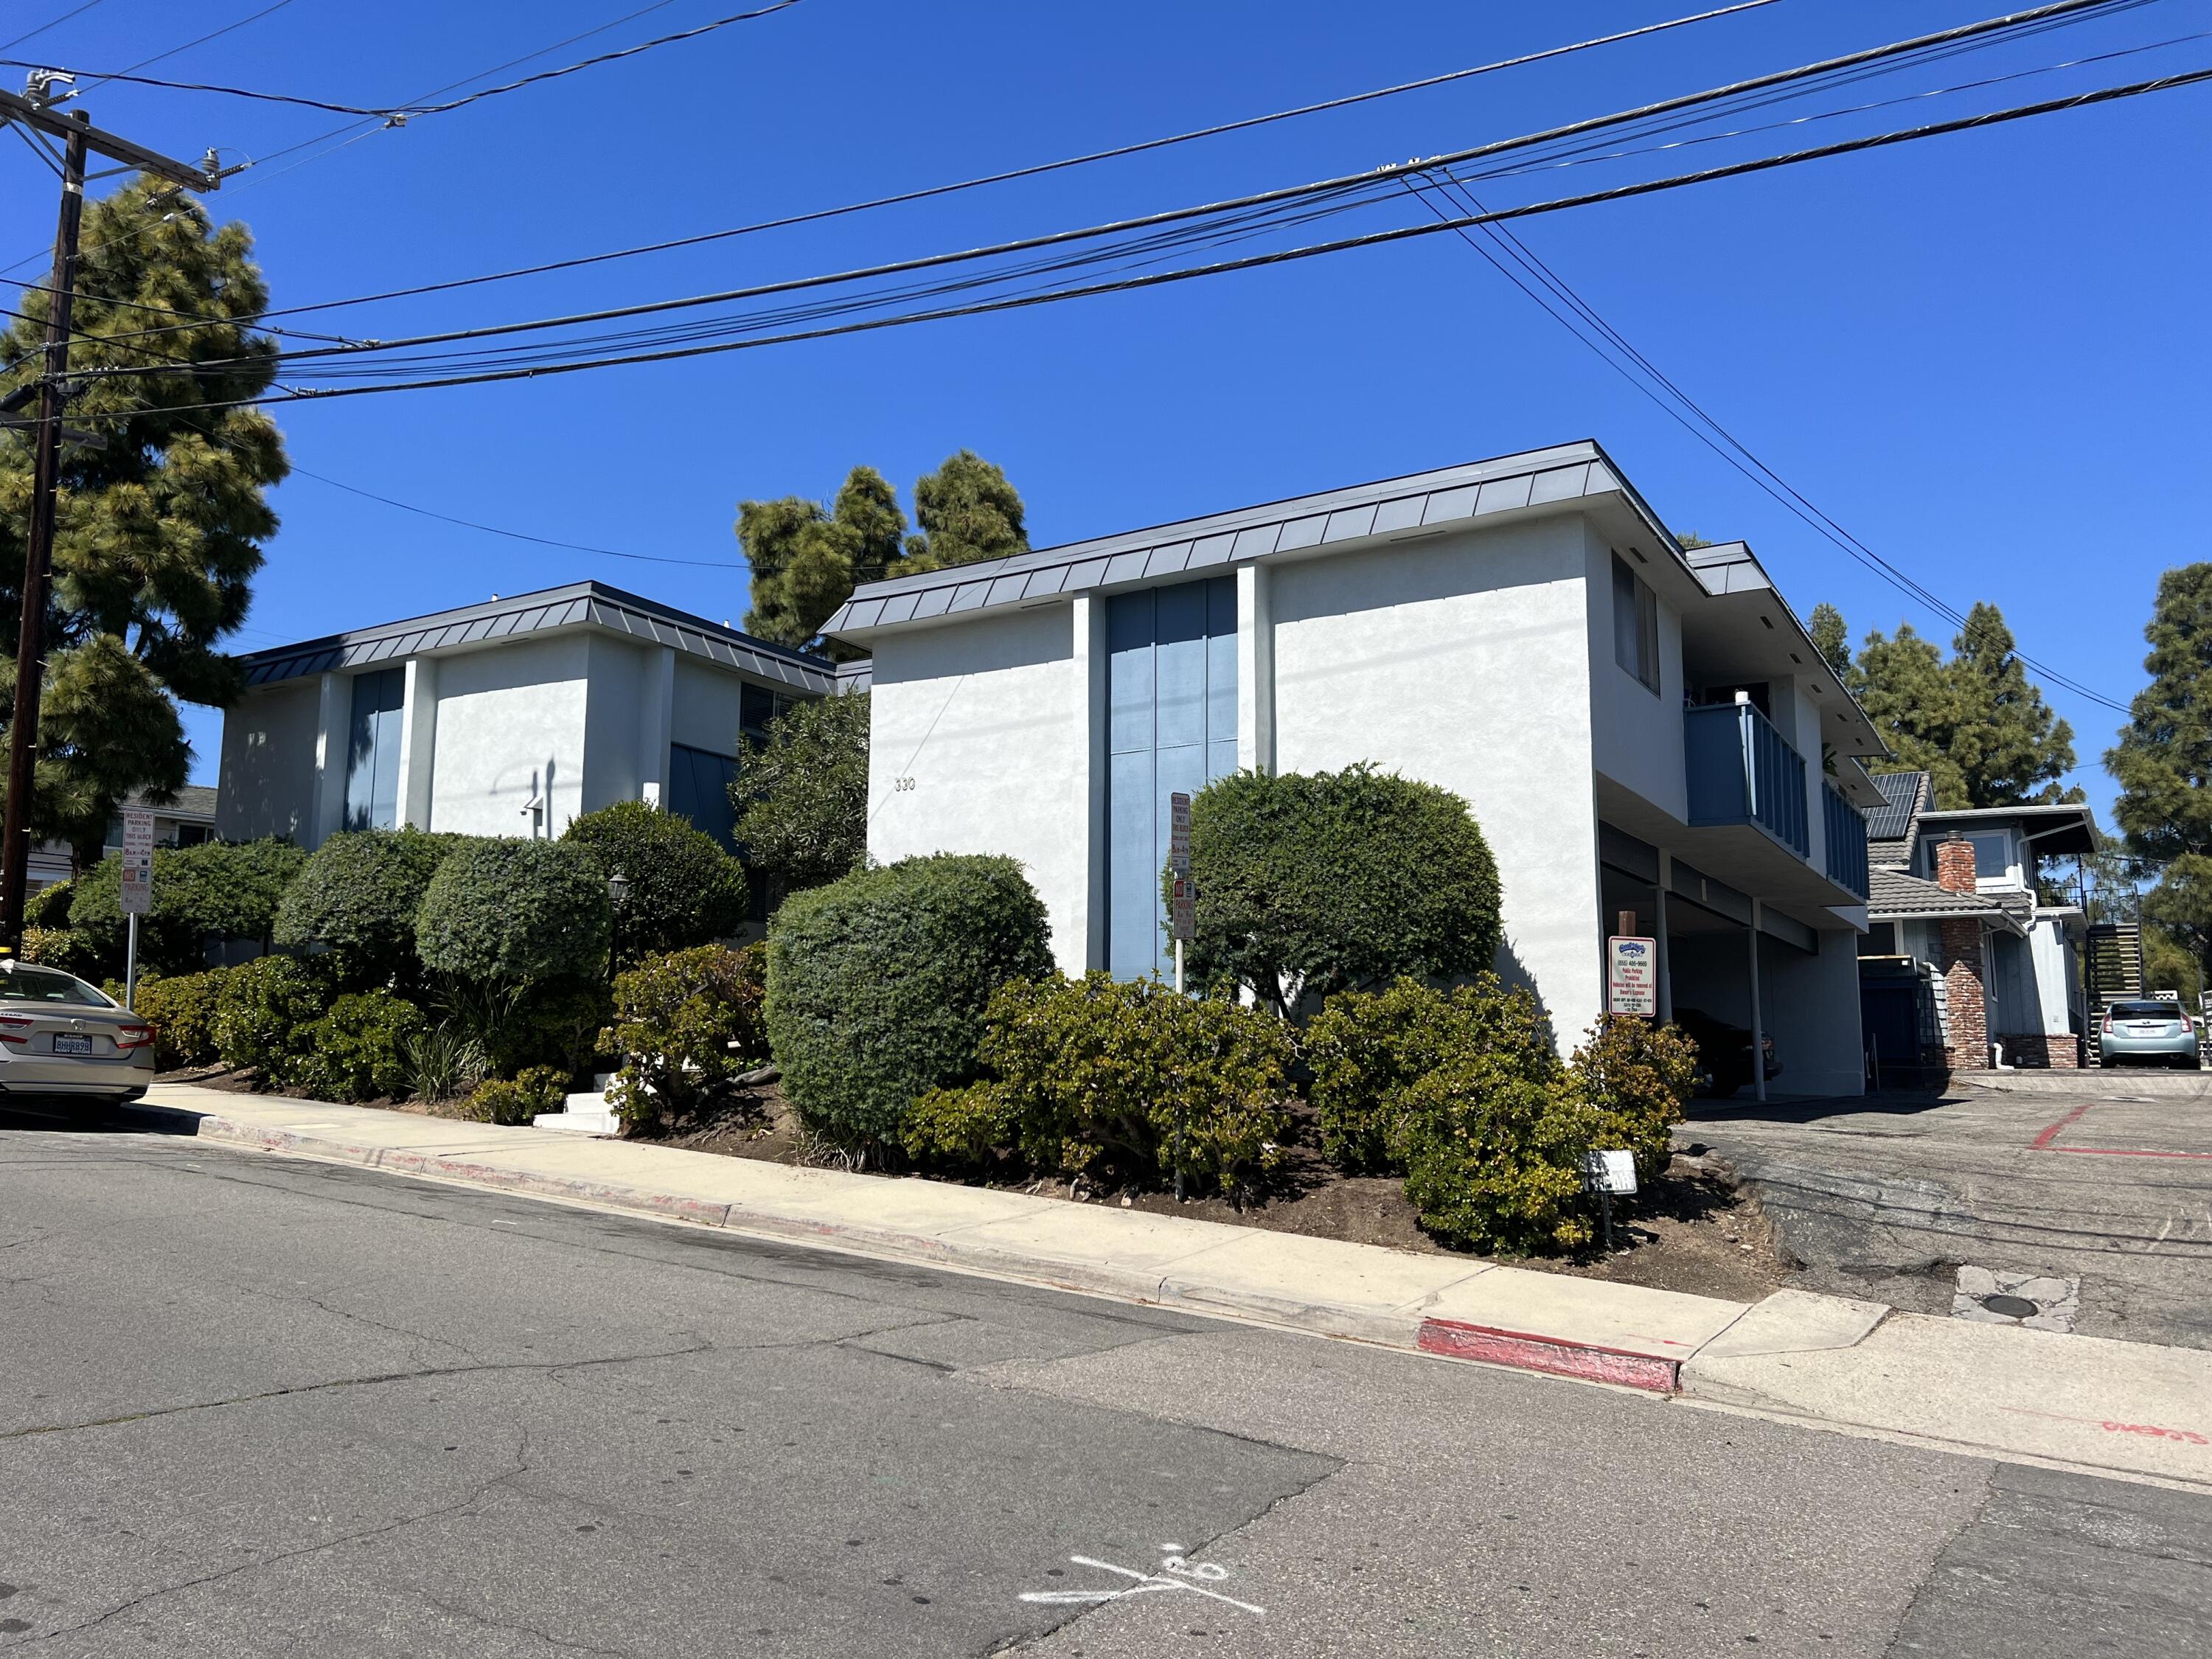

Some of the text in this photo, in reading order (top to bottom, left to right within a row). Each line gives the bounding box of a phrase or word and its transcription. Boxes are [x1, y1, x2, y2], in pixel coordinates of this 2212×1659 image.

[894, 776, 916, 792] 330
[1172, 796, 1189, 805] RESIDENT
[1173, 805, 1188, 815] PARKING
[1176, 815, 1185, 823] ONLY
[1180, 824, 1189, 832] BLOCK
[125, 870, 134, 880] NO
[124, 883, 150, 892] PARKING
[1175, 883, 1183, 896] NO
[1175, 900, 1193, 909] PARKING
